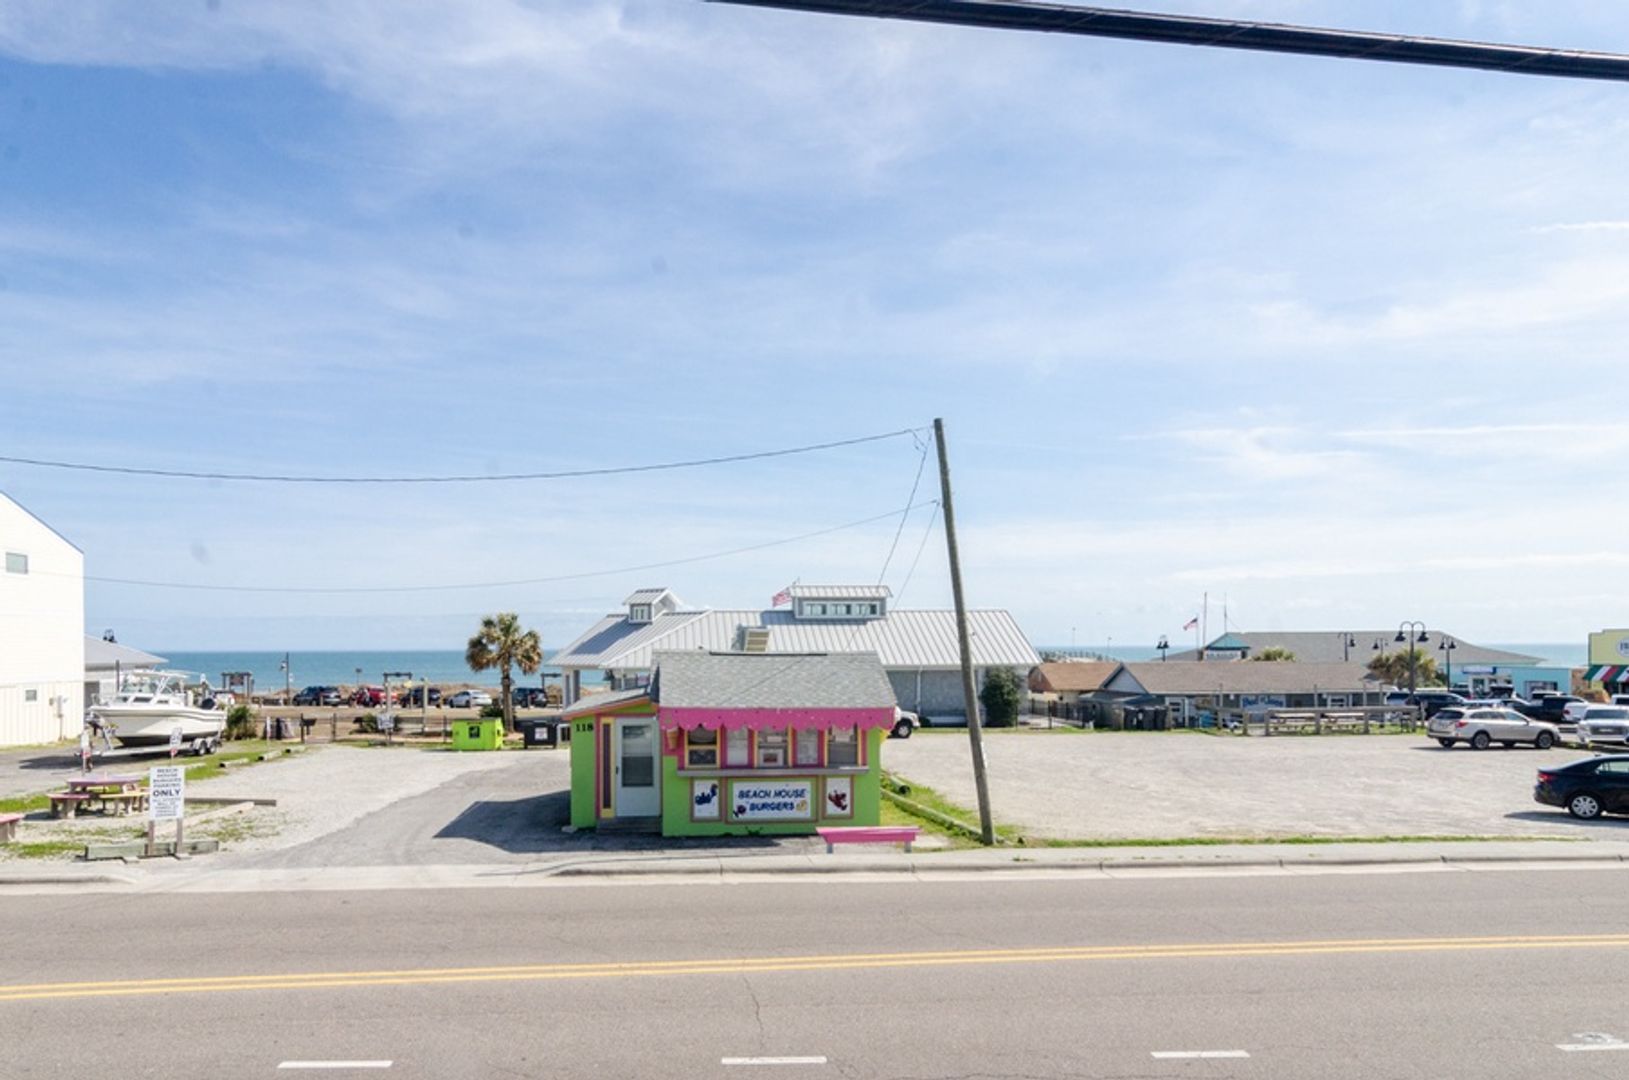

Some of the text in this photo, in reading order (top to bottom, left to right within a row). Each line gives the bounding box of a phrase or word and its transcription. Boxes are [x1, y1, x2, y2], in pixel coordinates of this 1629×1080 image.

[576, 723, 593, 732] 118
[153, 789, 181, 797] ONLY
[738, 788, 807, 799] BEACH HOUSE
[749, 801, 794, 812] BURGERS
